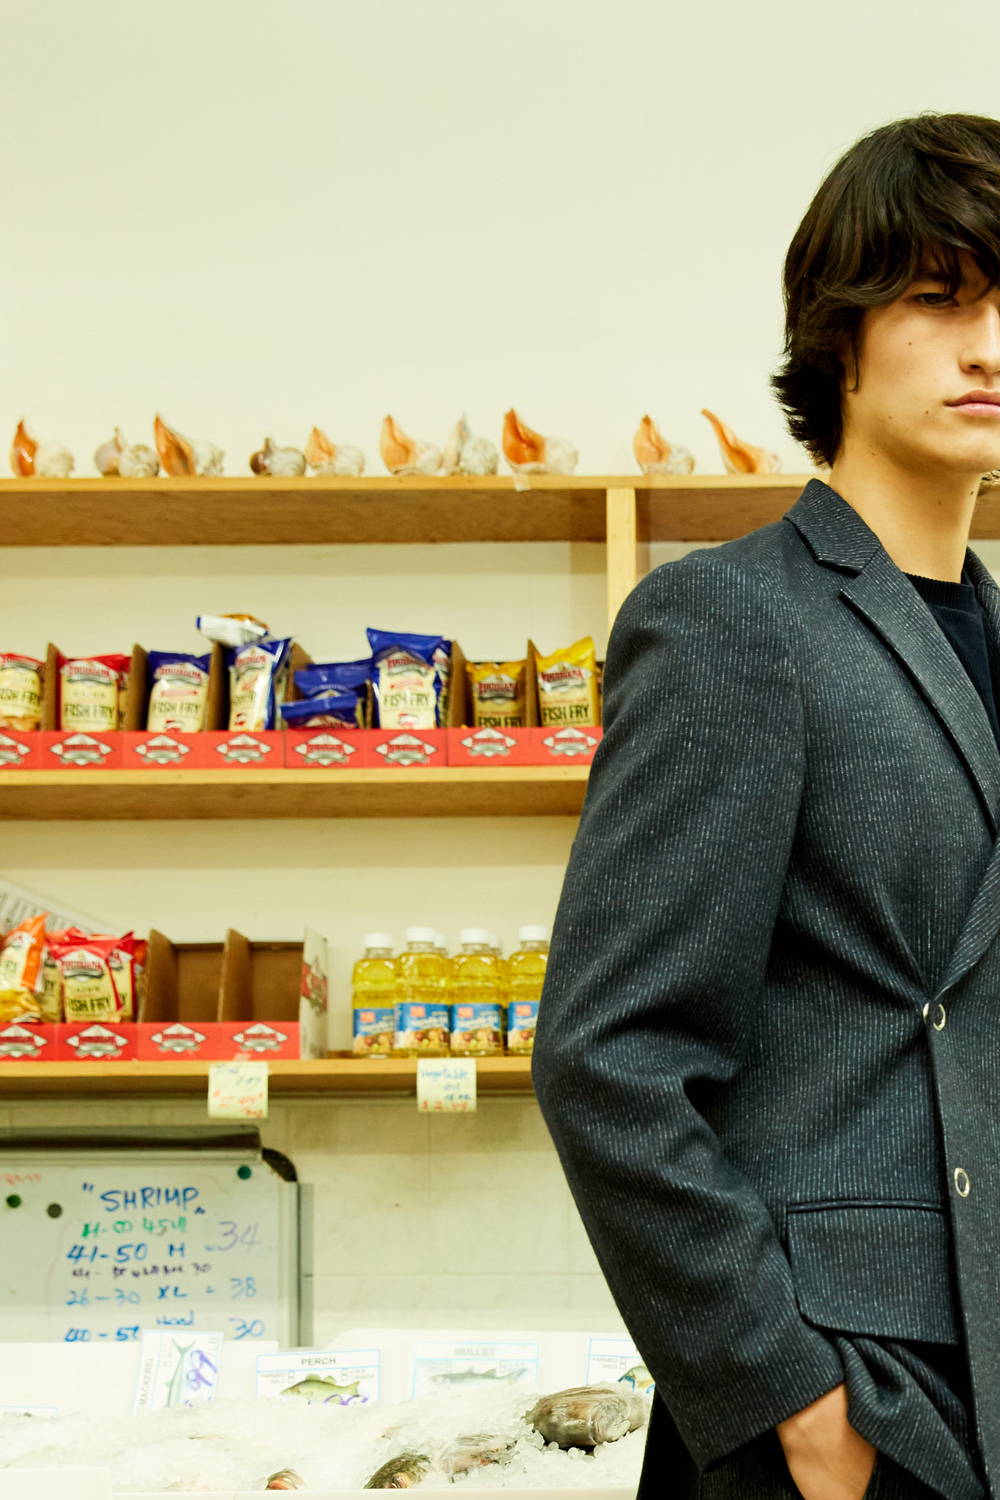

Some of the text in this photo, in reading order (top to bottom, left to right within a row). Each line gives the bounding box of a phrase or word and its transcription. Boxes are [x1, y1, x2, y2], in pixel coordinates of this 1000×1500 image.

[543, 704, 590, 720] FISH FRY
[301, 1357, 337, 1366] PERCH
